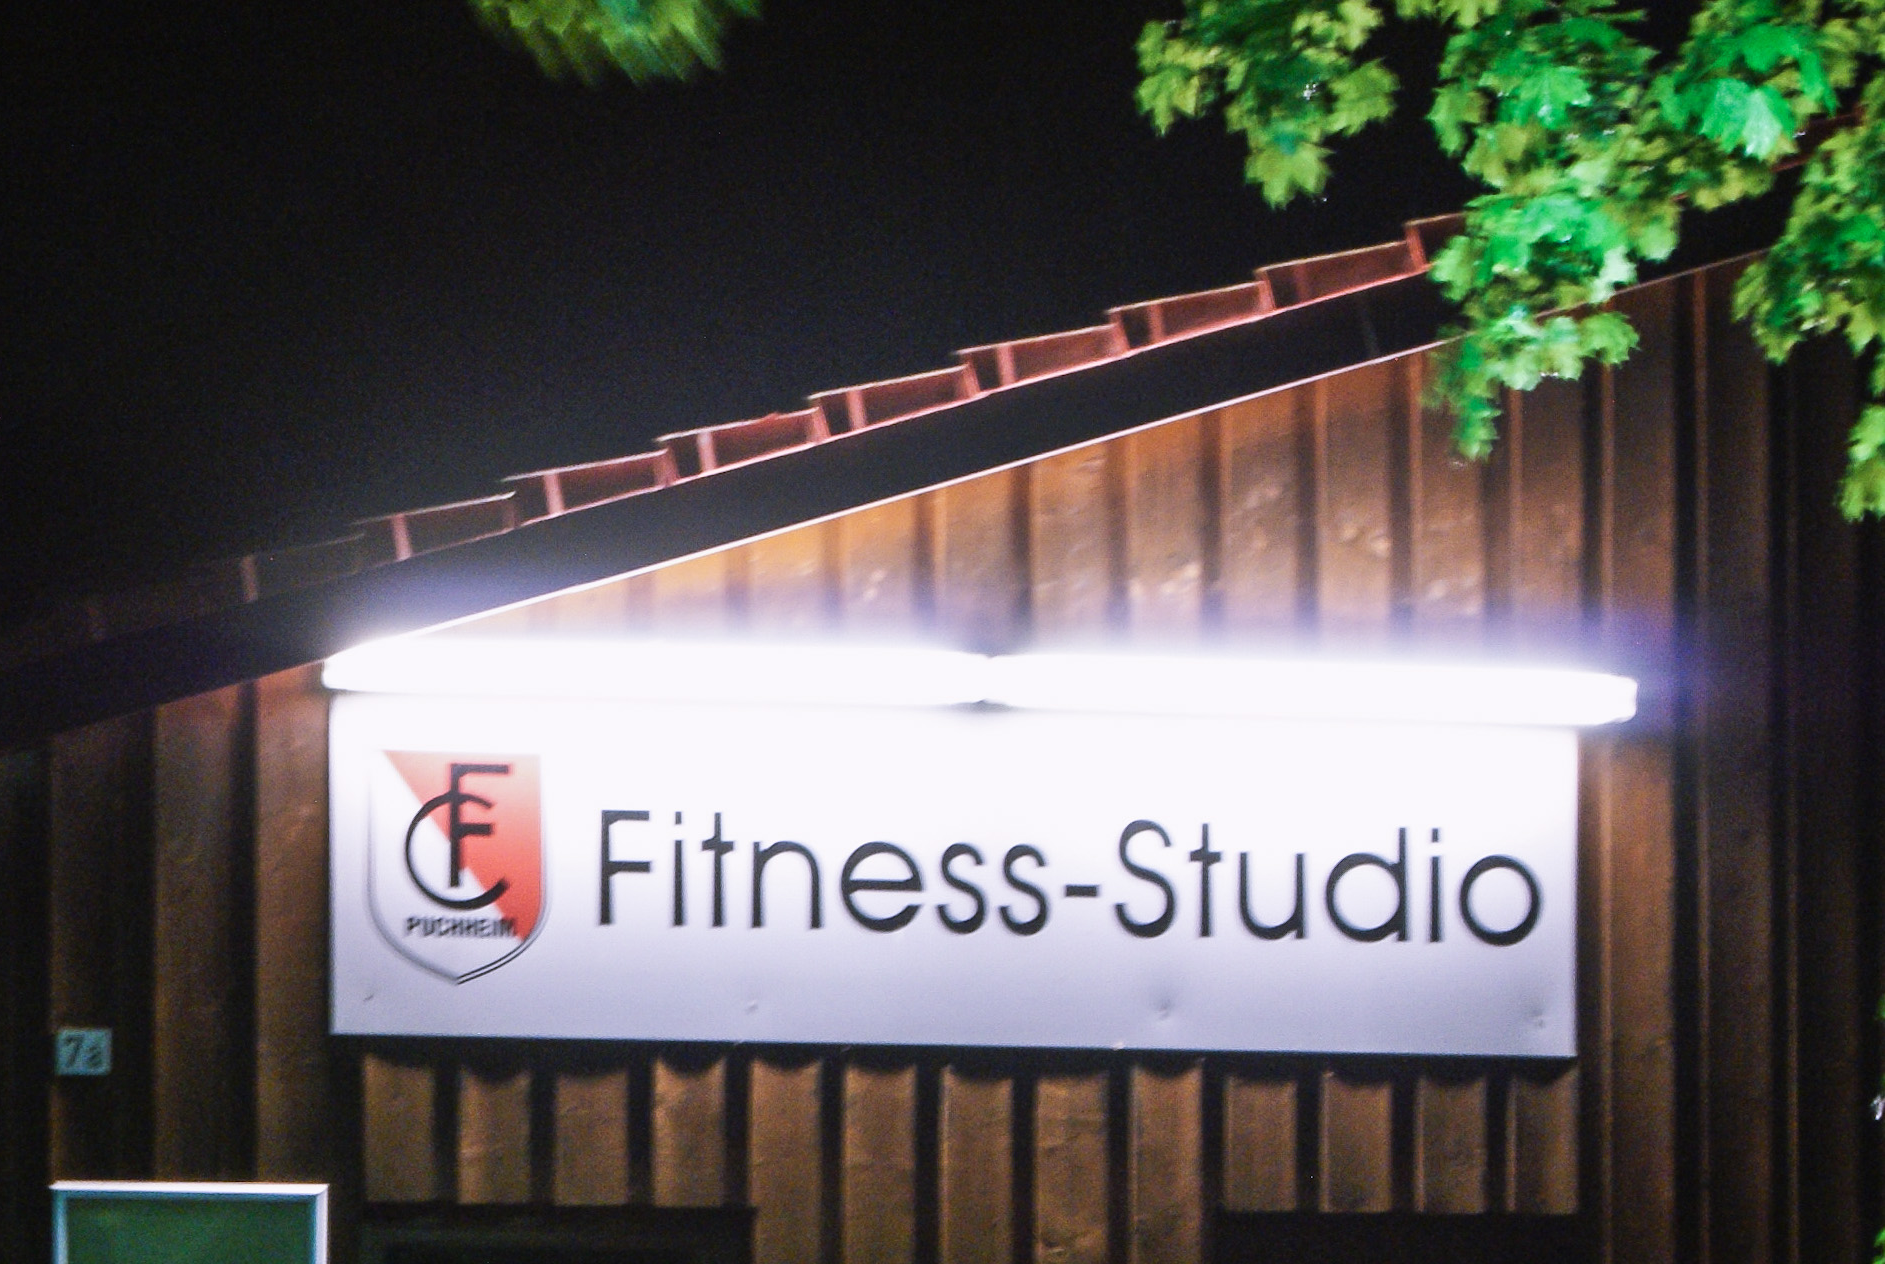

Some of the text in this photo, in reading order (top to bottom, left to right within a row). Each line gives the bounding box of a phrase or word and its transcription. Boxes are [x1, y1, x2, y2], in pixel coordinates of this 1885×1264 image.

[597, 809, 1542, 946] Fitness-Studio
[406, 917, 516, 939] PUCHHEIM
[63, 1033, 102, 1069] 7a
